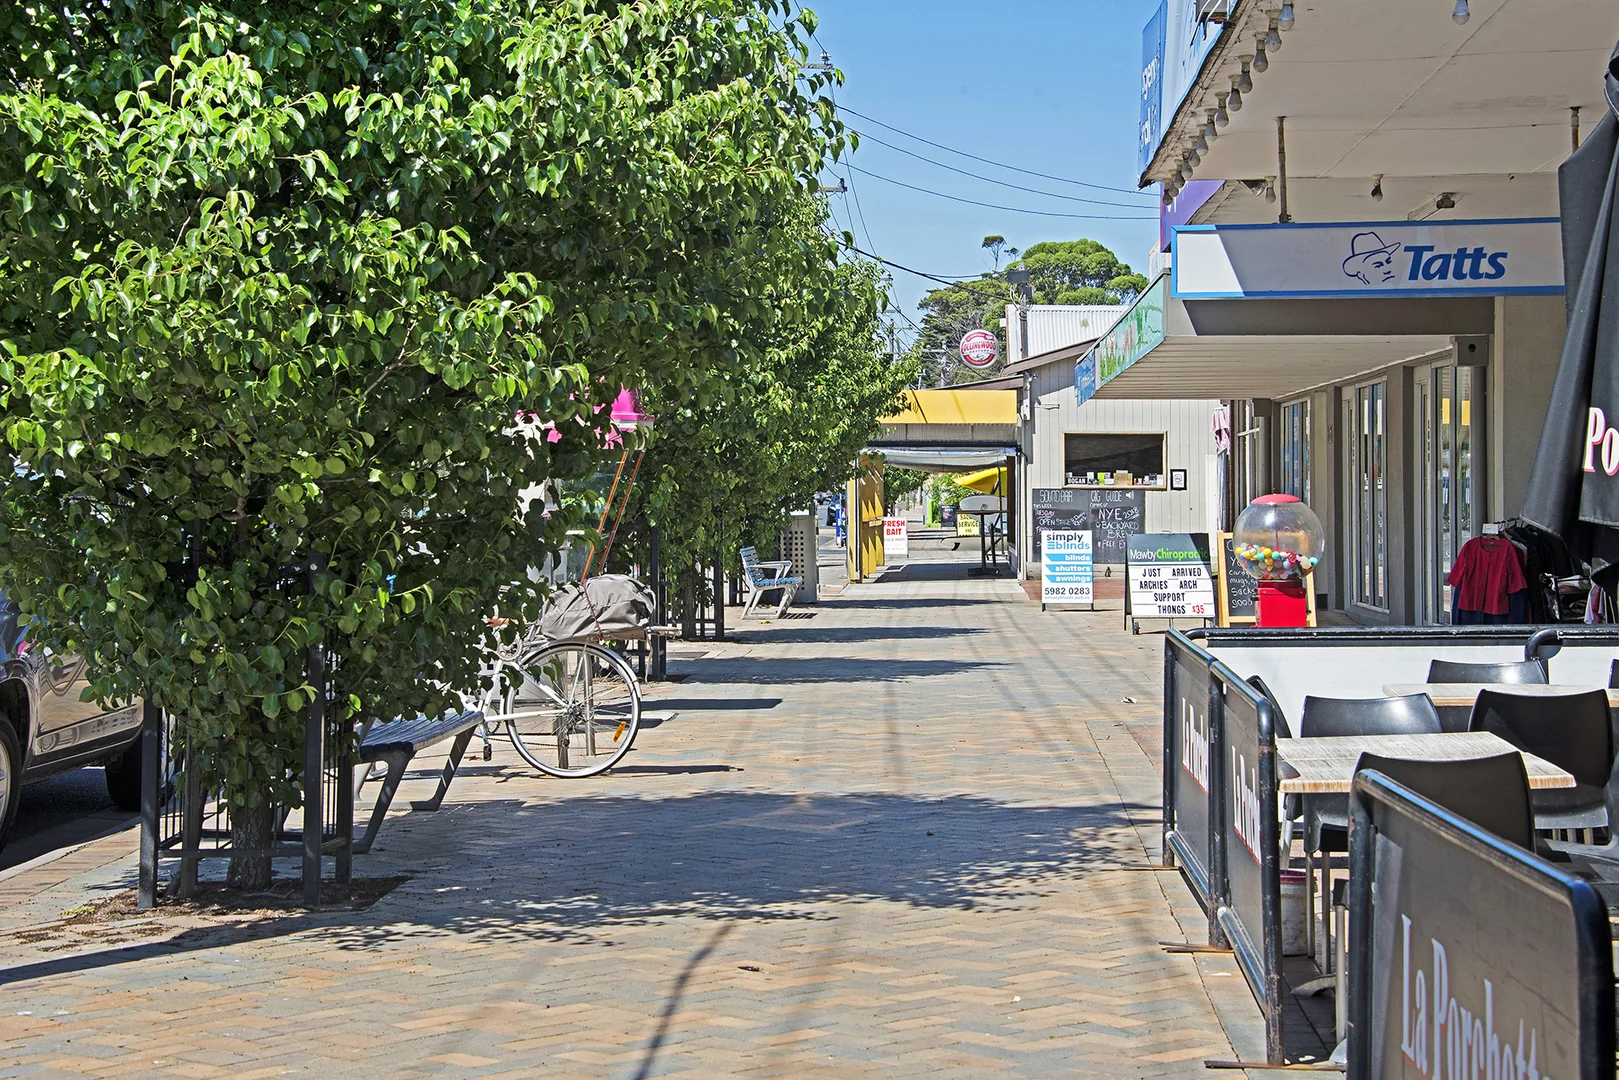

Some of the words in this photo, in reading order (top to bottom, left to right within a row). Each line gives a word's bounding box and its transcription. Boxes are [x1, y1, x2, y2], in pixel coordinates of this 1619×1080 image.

[1403, 245, 1508, 281] Tatts
[1105, 490, 1122, 502] GUIDE
[1098, 508, 1122, 520] NYE
[1122, 507, 1139, 519] 2018
[1101, 520, 1139, 530] BACKYARD
[1046, 532, 1083, 542] simply
[1056, 541, 1090, 550] blinds
[1142, 568, 1161, 577] JUST
[1172, 567, 1202, 577] ARRIVED
[1055, 575, 1091, 583] awnings
[1139, 580, 1168, 590] ARCHIES
[1179, 580, 1198, 590] ARCH
[1044, 587, 1066, 595] 5982
[1068, 587, 1091, 595] 0283
[1153, 592, 1185, 602] SUPPORT
[1157, 605, 1186, 614] THONGS
[1191, 604, 1205, 614] $35
[1401, 913, 1428, 1076] La
